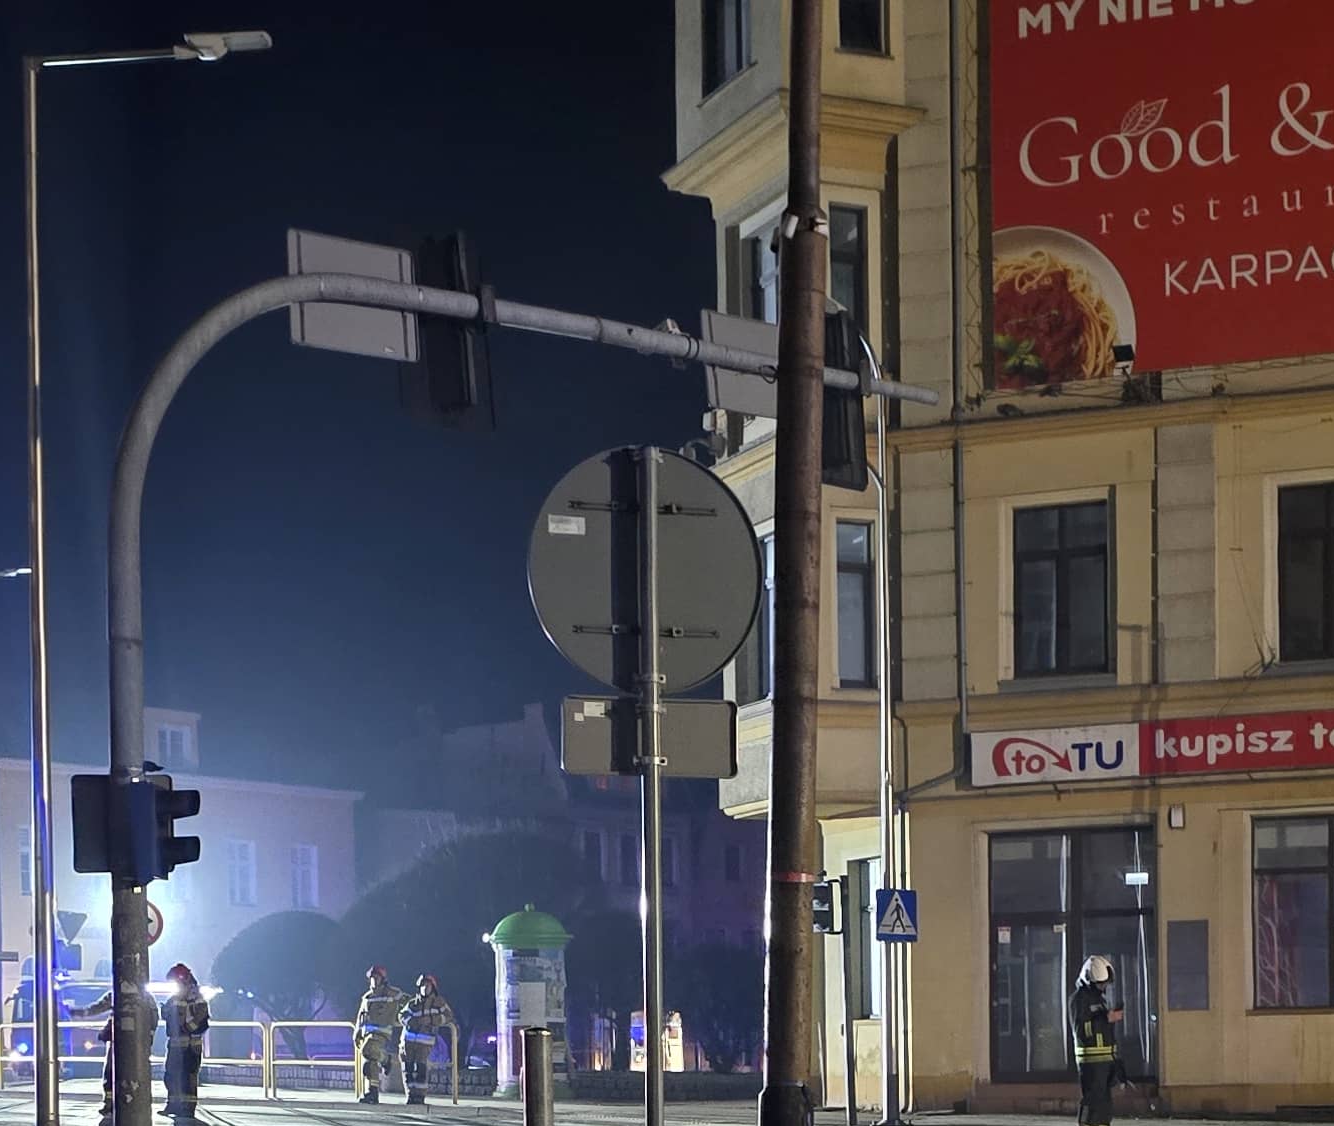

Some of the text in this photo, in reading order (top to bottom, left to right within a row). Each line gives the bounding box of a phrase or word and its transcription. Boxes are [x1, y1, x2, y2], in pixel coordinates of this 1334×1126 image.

[1017, 1, 1083, 39] MY
[1018, 84, 1239, 188] Good
[1071, 739, 1124, 772] TU
[1155, 722, 1294, 765] kupisz
